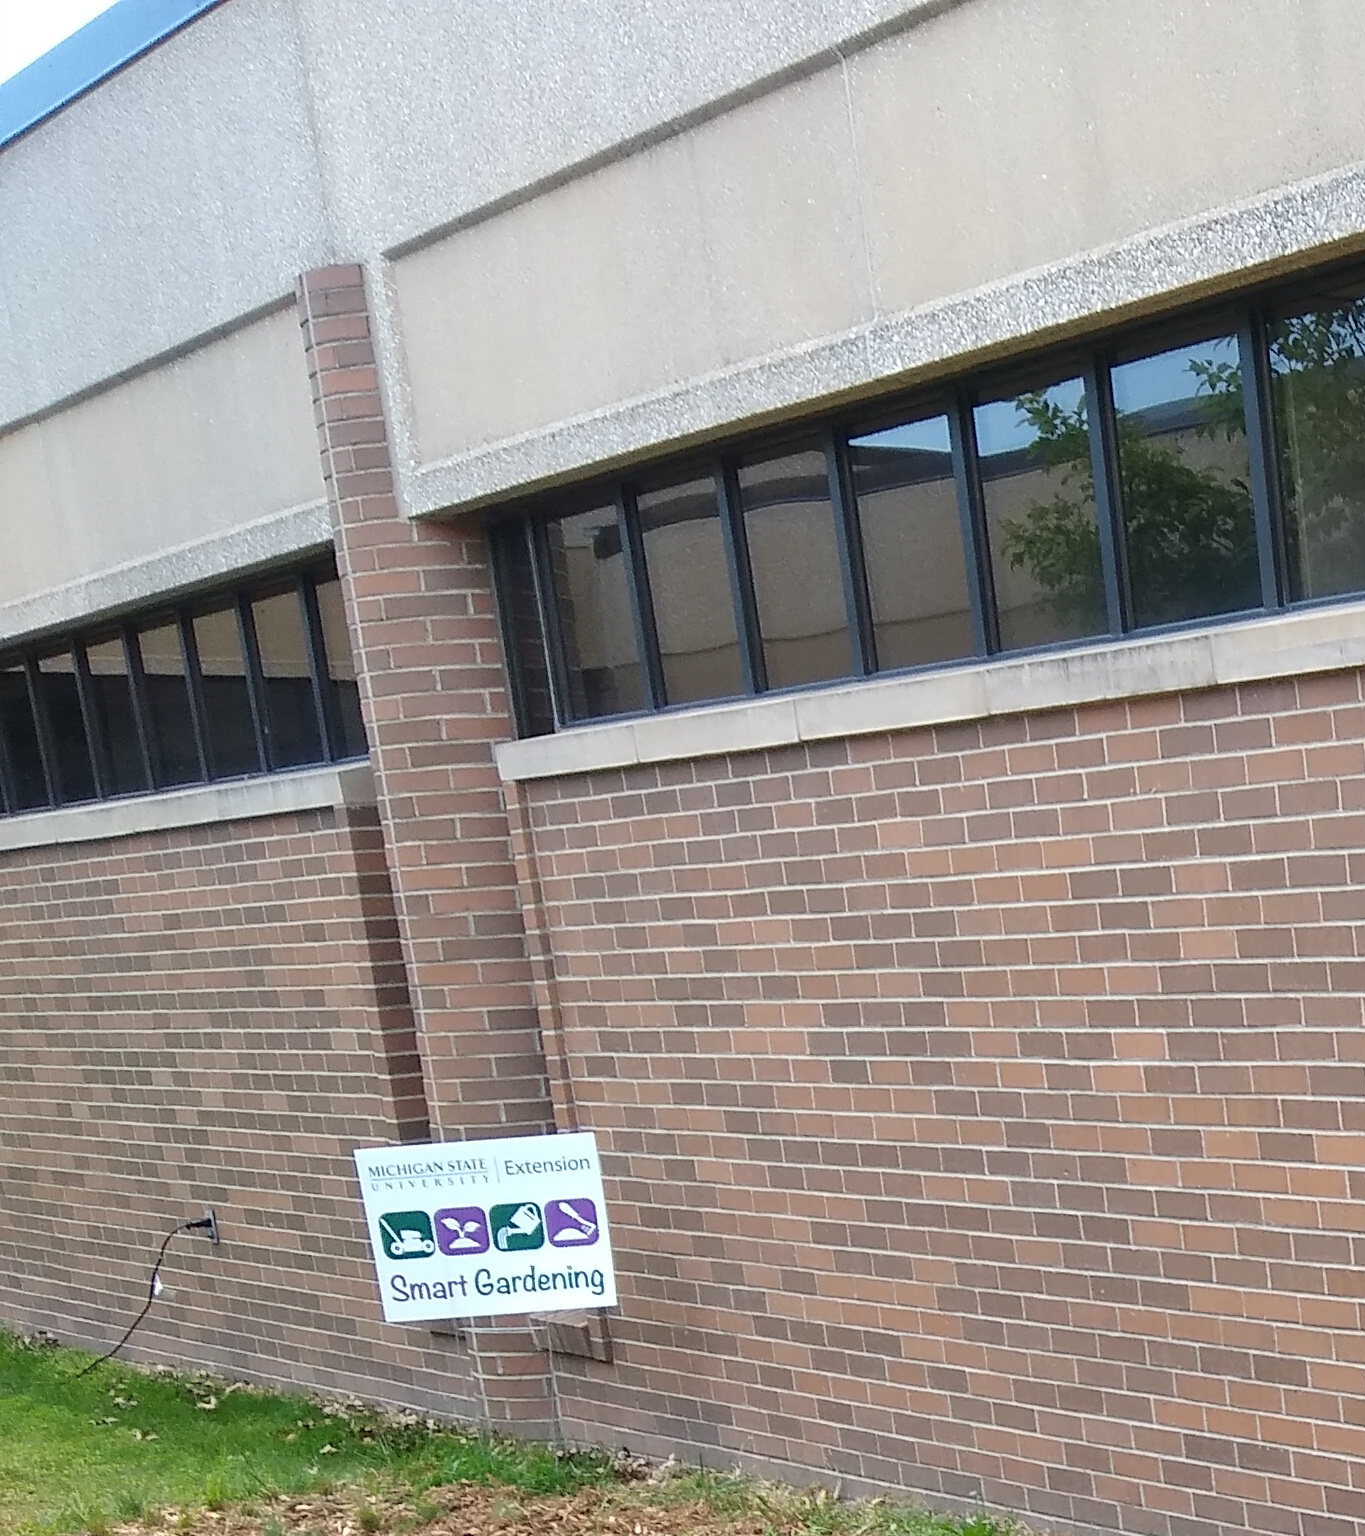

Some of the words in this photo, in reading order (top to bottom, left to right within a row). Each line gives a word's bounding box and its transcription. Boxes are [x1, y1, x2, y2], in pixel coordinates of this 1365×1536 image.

[368, 1160, 444, 1178] MICHIGAN
[447, 1157, 488, 1172] STATE
[504, 1156, 591, 1176] Extension
[371, 1174, 489, 1191] UNIVERSITY
[390, 1274, 468, 1302] Smart
[474, 1265, 605, 1296] Gardening
